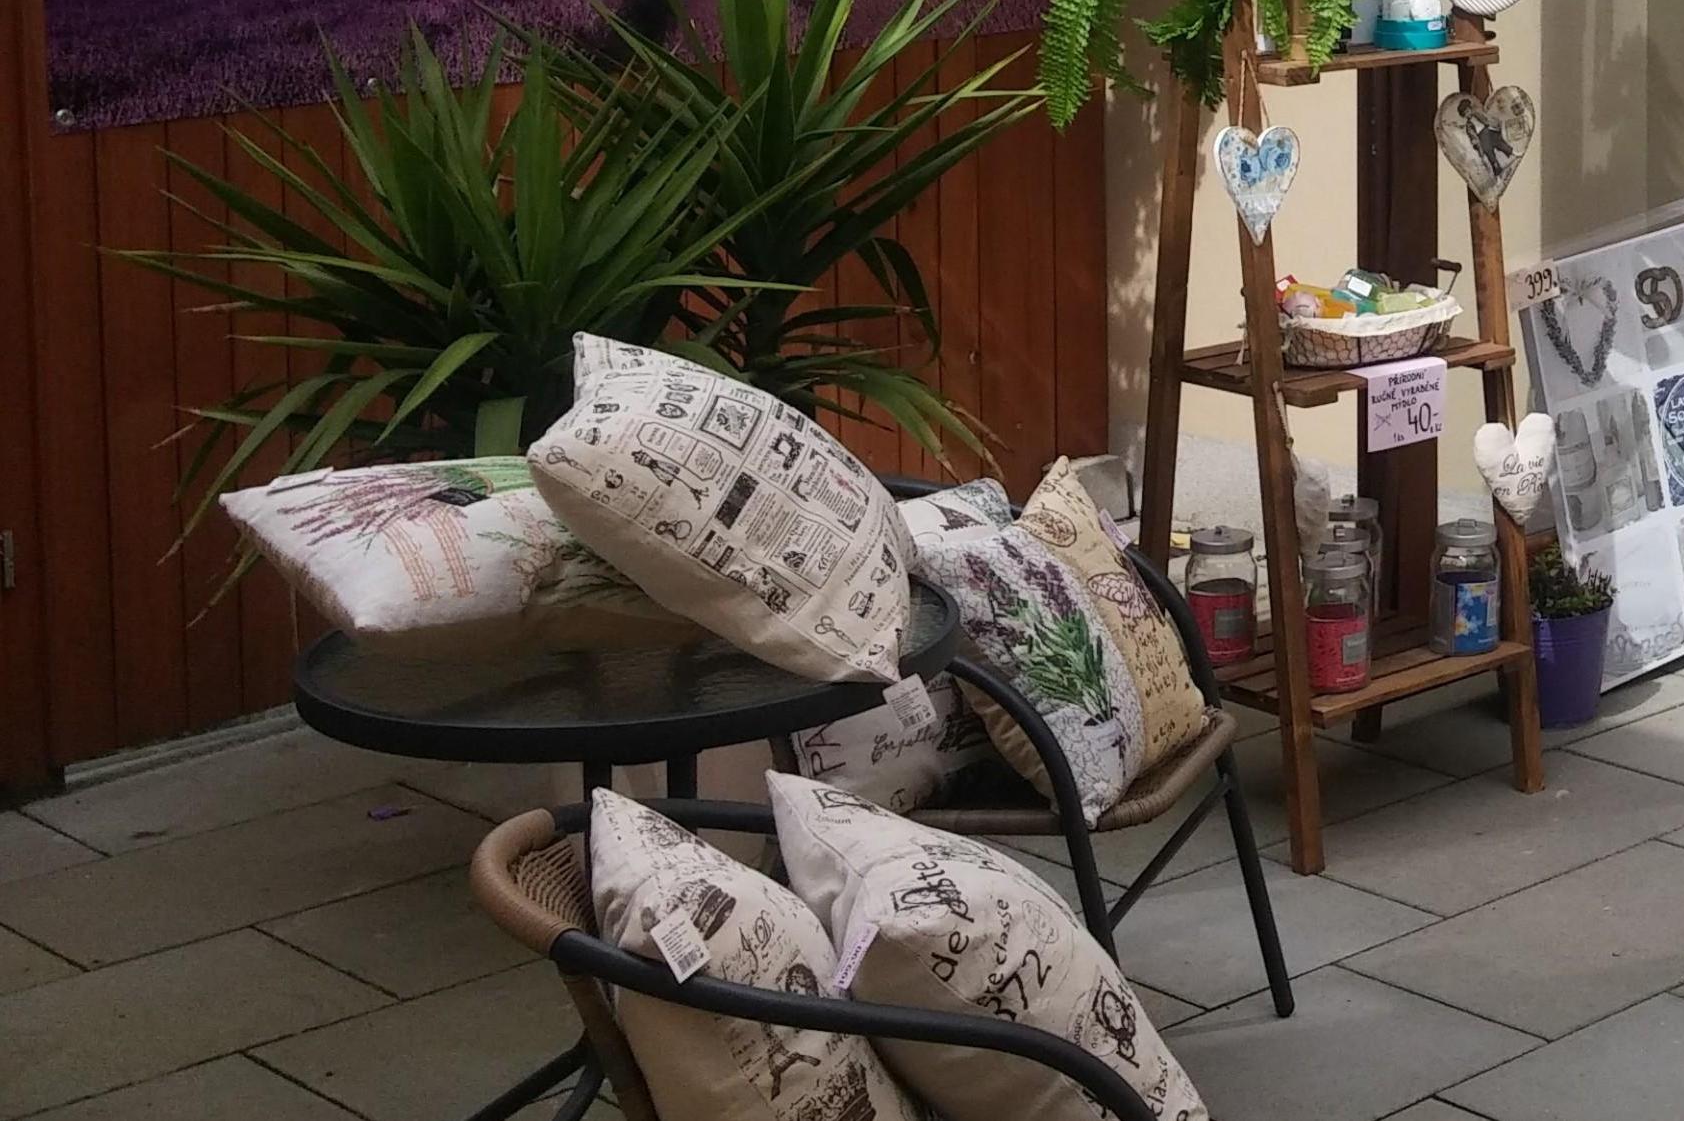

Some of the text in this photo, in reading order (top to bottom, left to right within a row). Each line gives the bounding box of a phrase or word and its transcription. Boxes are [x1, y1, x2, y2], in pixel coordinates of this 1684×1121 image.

[1528, 455, 1544, 469] vie
[931, 930, 969, 982] de
[993, 899, 1013, 966] classe
